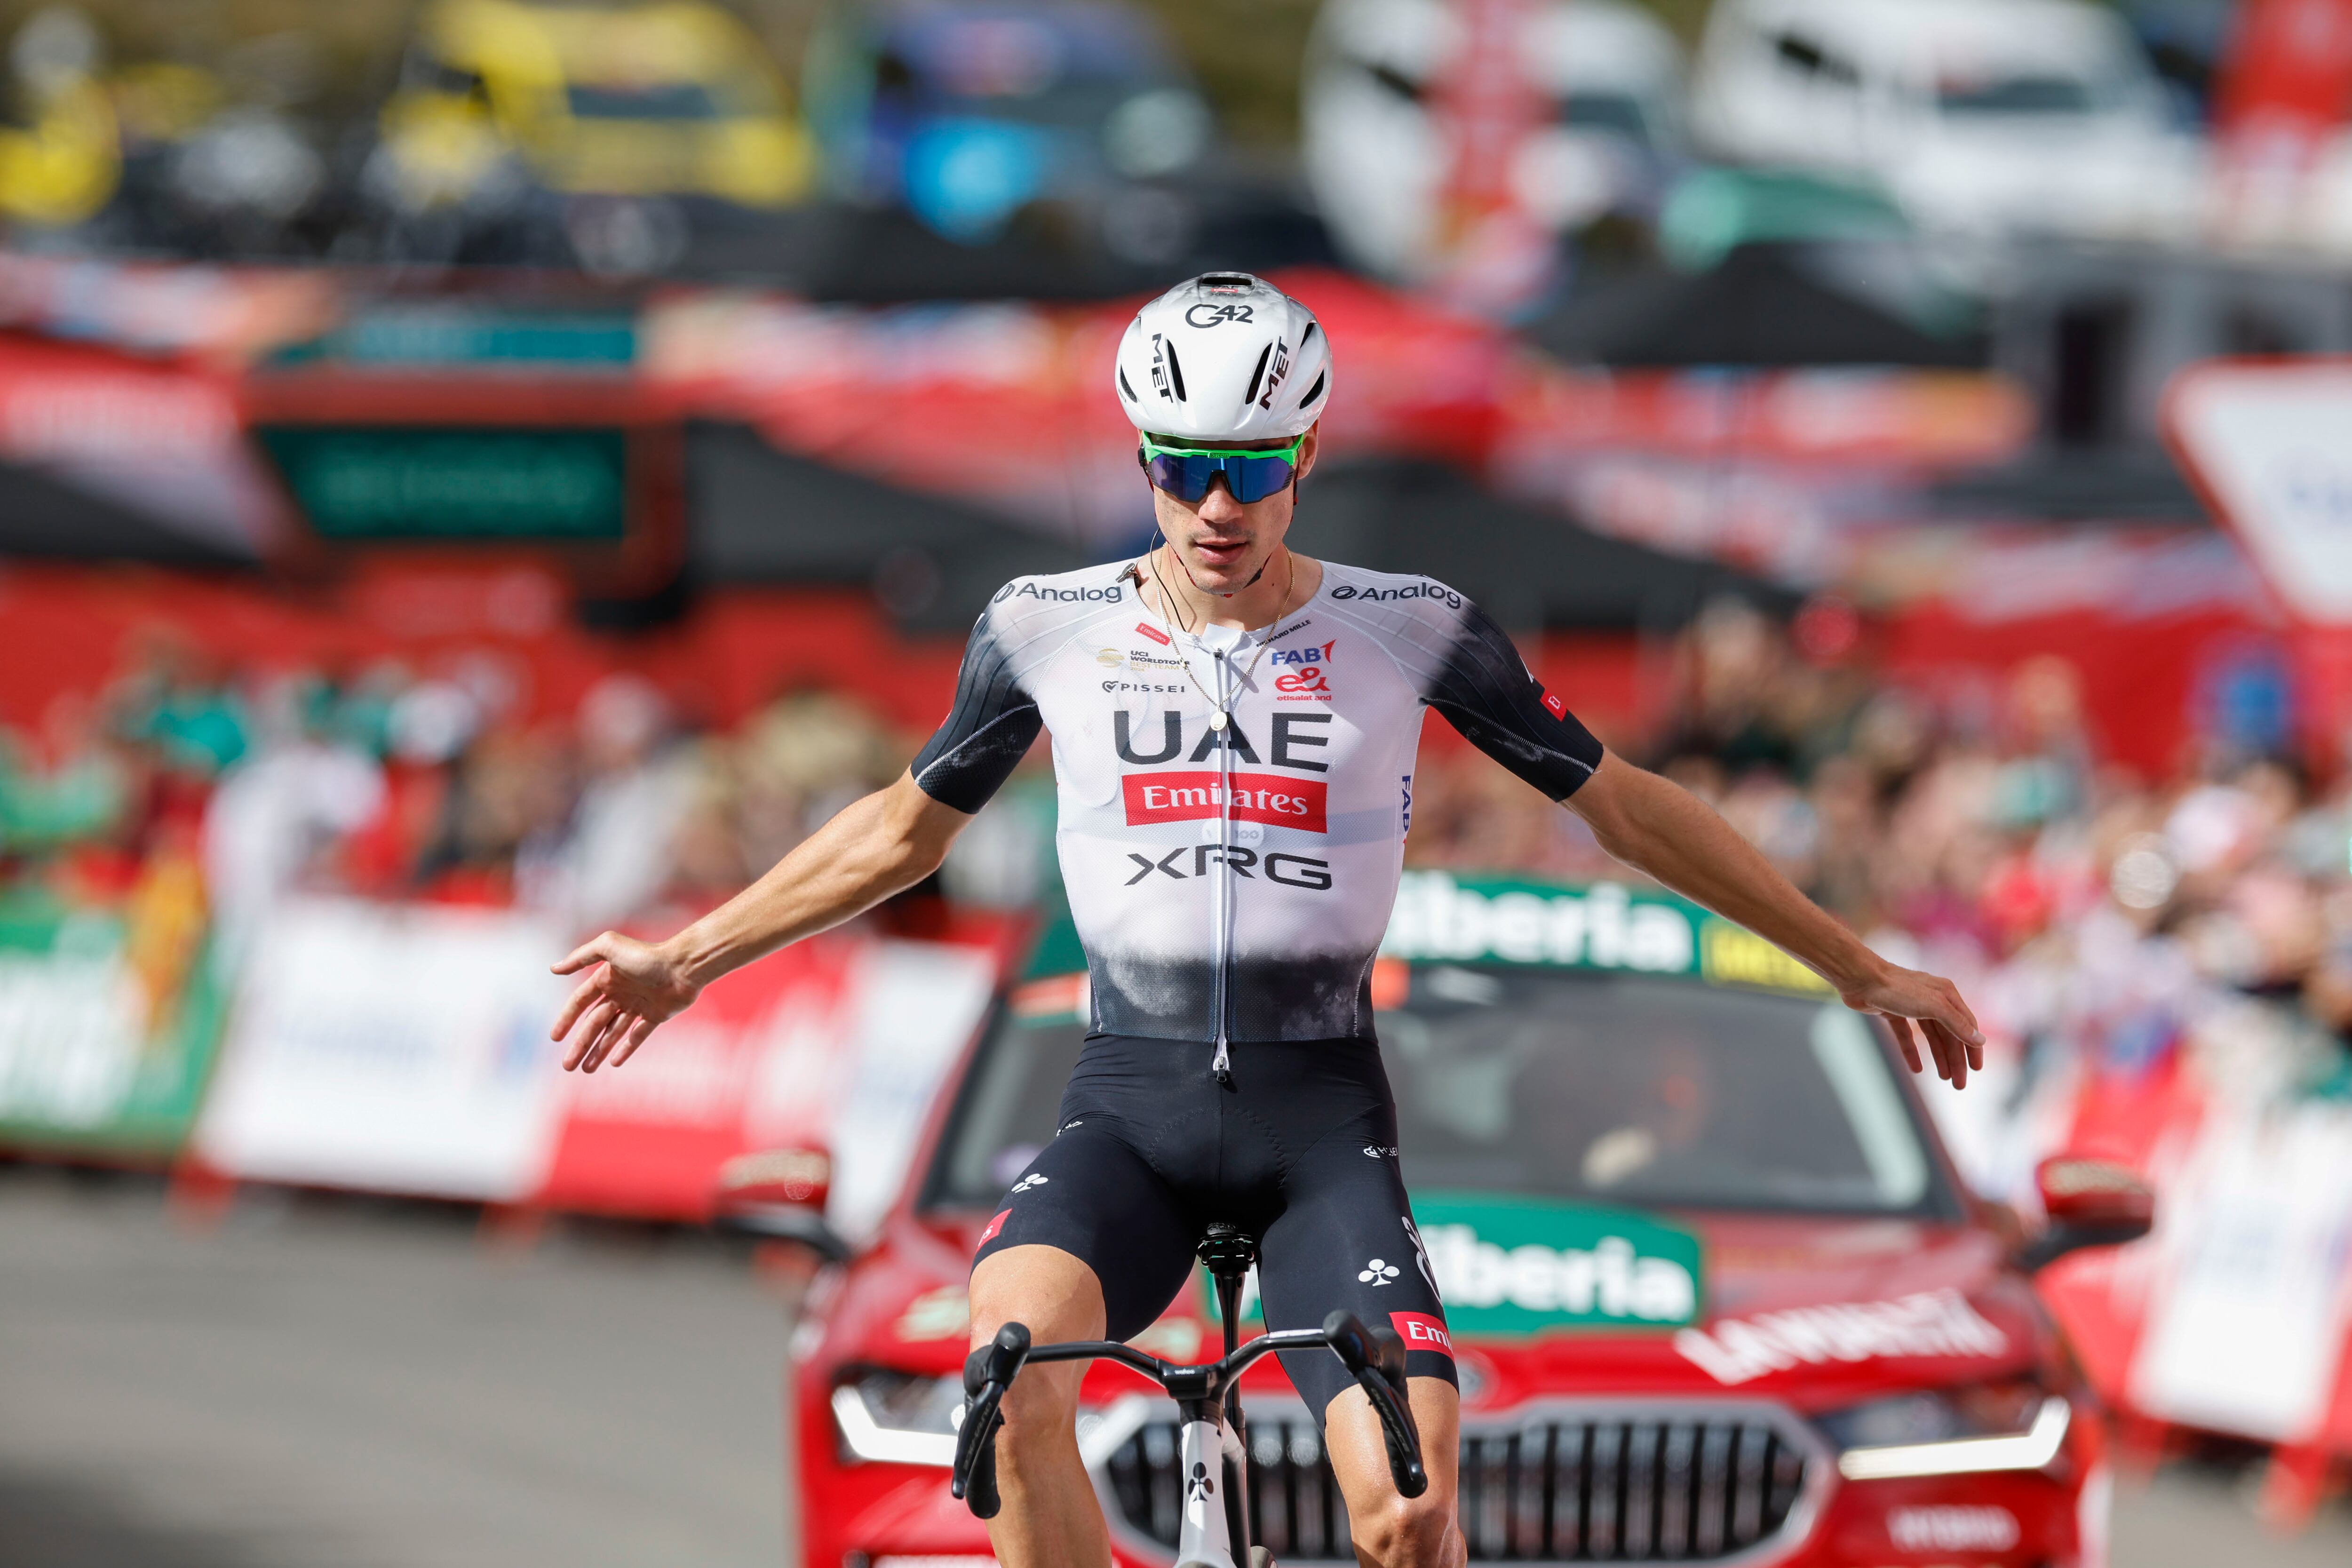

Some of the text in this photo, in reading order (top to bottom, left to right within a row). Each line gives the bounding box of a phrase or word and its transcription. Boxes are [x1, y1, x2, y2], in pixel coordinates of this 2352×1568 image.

[1185, 303, 1253, 328] G42
[1151, 333, 1173, 403] MET
[1259, 336, 1290, 410] MET
[1017, 582, 1122, 604] Analog
[1358, 582, 1461, 609] Analog
[1139, 625, 1167, 643] Emirates
[1289, 620, 1311, 633] MILLE
[1271, 647, 1321, 666] FAB
[1120, 683, 1184, 692] PISSEI
[1114, 710, 1333, 772] UAE
[1402, 775, 1411, 832] FAB
[1124, 844, 1332, 891] XRG
